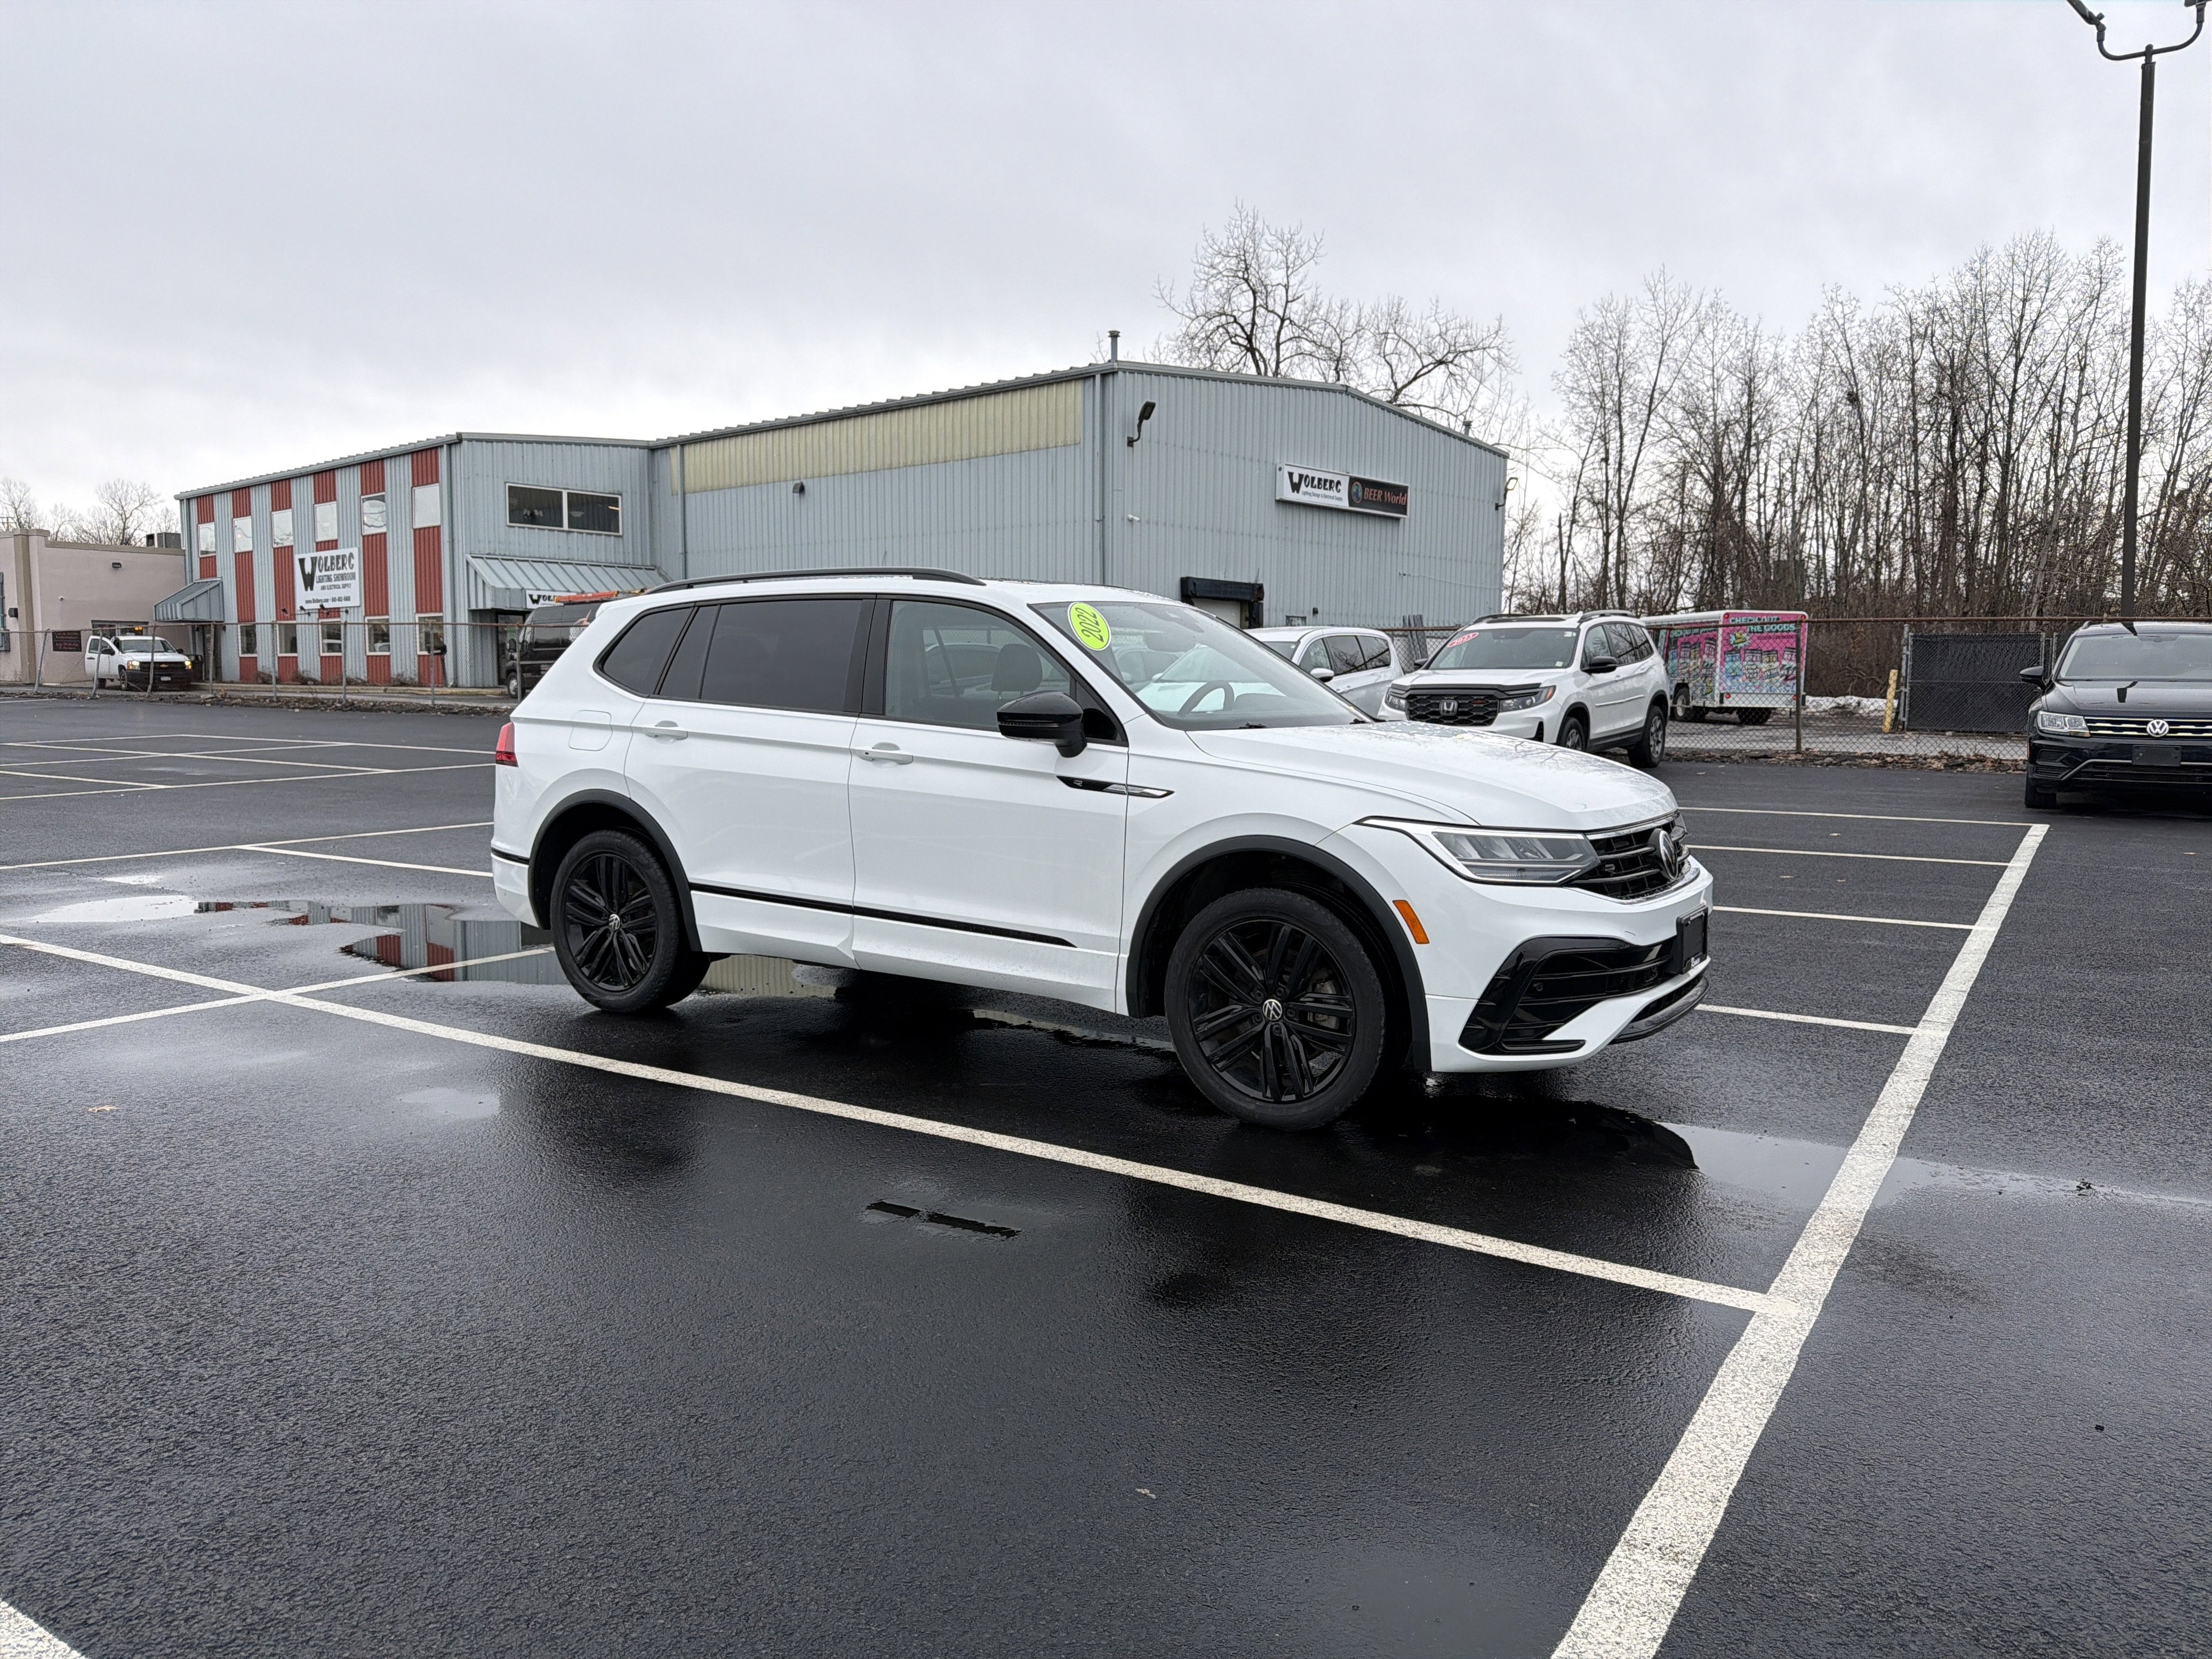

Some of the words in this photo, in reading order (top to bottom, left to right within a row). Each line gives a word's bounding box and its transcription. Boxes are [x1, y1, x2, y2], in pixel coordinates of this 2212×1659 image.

[1364, 487, 1383, 502] BEER
[1384, 490, 1407, 505] World
[1075, 607, 1104, 643] 2022
[1764, 623, 1796, 631] GOODS
